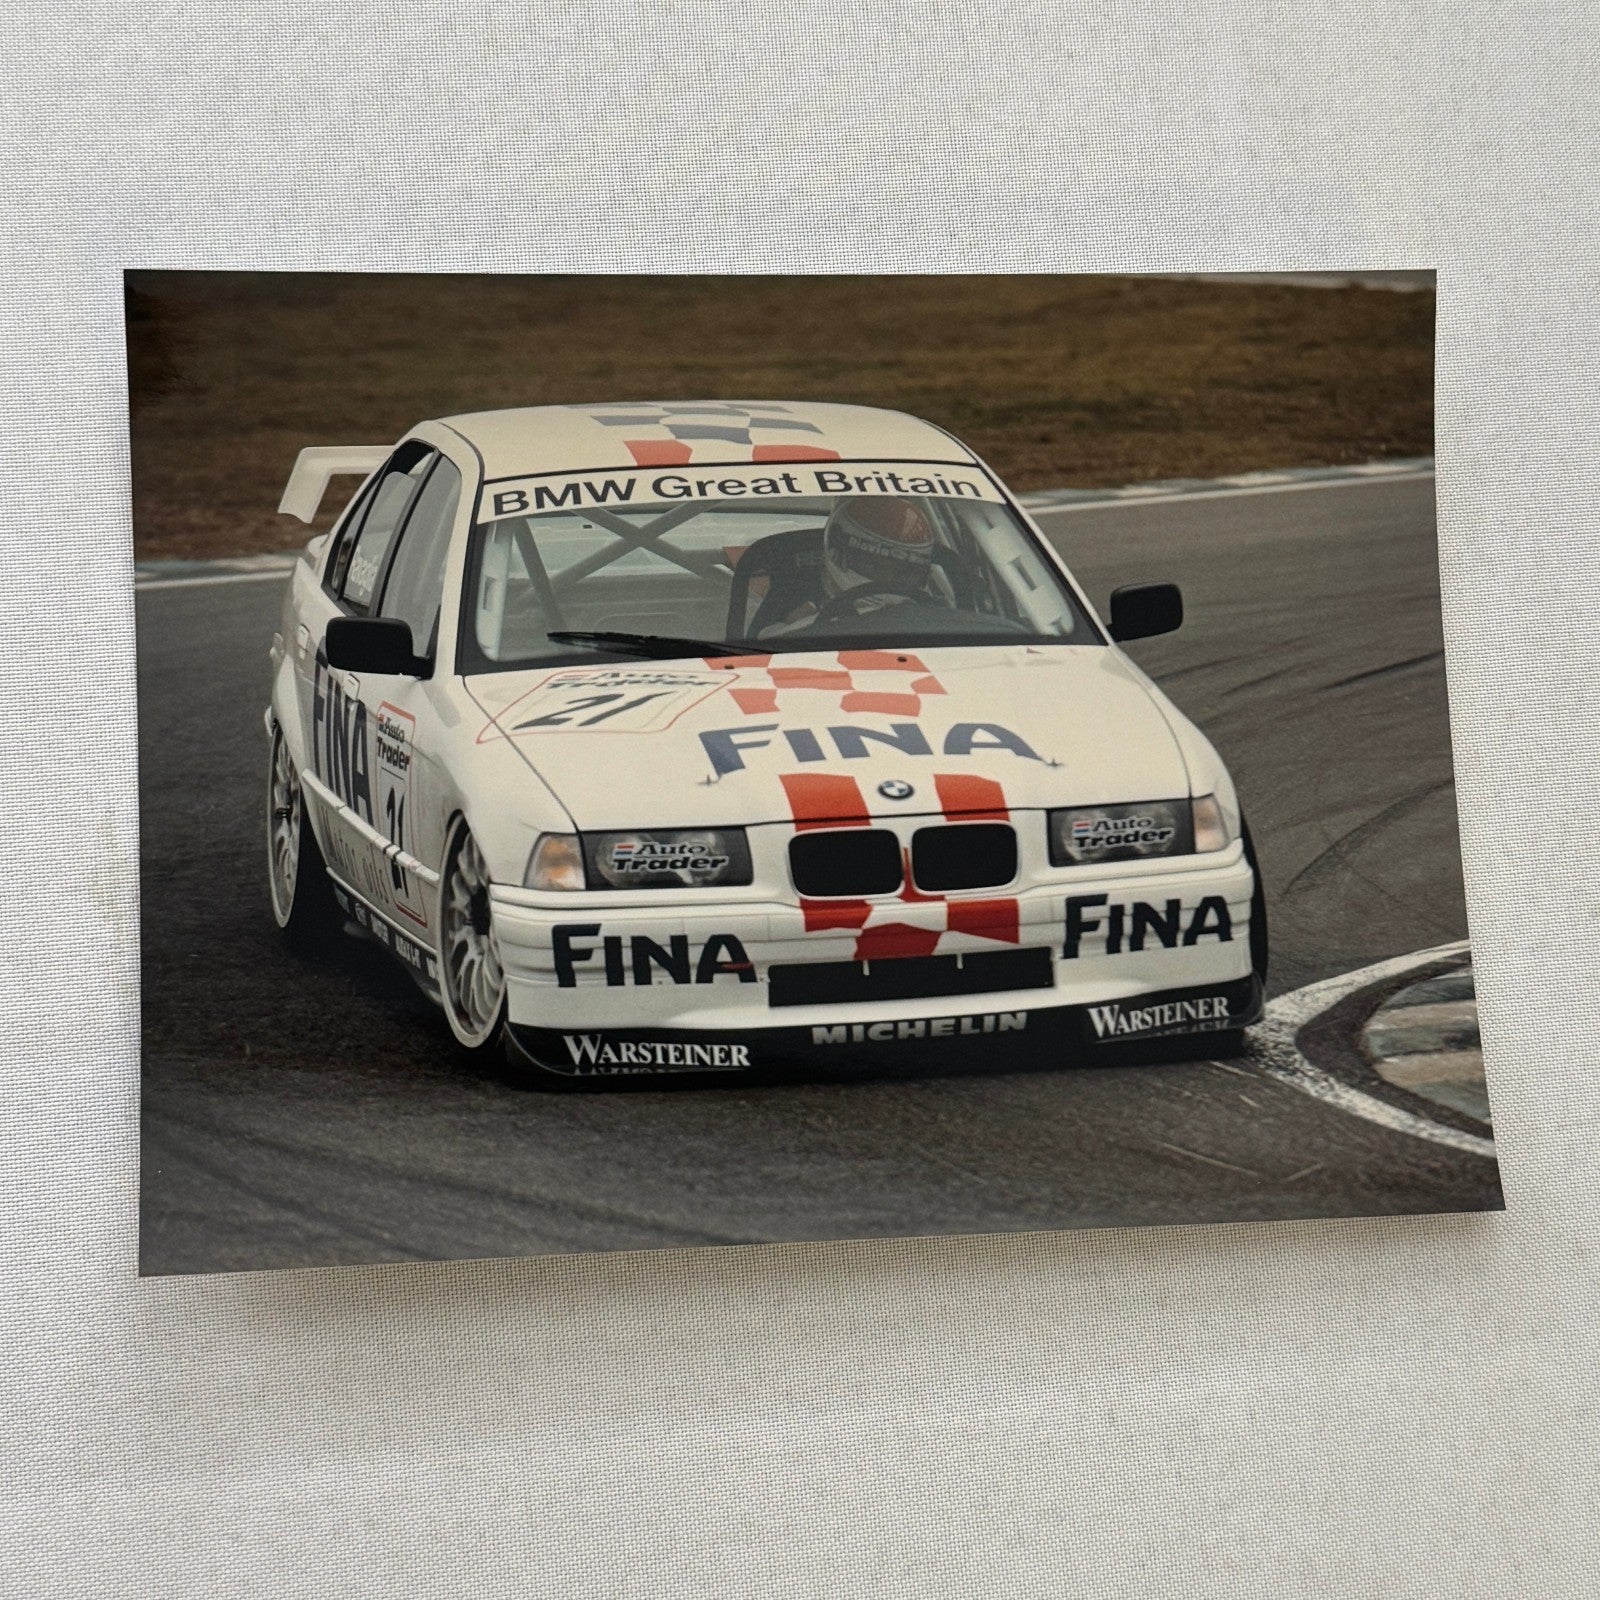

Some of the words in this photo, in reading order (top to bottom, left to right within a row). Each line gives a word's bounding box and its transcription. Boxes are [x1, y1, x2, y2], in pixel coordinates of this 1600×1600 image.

[493, 478, 636, 516] BMW
[652, 473, 802, 499] Great
[814, 470, 983, 498] Britain
[590, 672, 698, 680] Auto
[512, 690, 677, 730] 21
[313, 645, 374, 828] FINA
[383, 716, 405, 743] Auto
[377, 736, 411, 772] Trader
[698, 723, 1043, 775] FINA
[1073, 828, 1172, 848] Trader
[1092, 818, 1152, 832] Auto
[612, 855, 729, 871] Trader
[633, 843, 706, 855] Auto
[1062, 893, 1234, 960] FINA
[552, 923, 757, 988] FINA
[812, 1011, 1028, 1045] MICHELIN
[1087, 996, 1230, 1038] WARSTEINER
[563, 1033, 751, 1066] WARSTEINER
